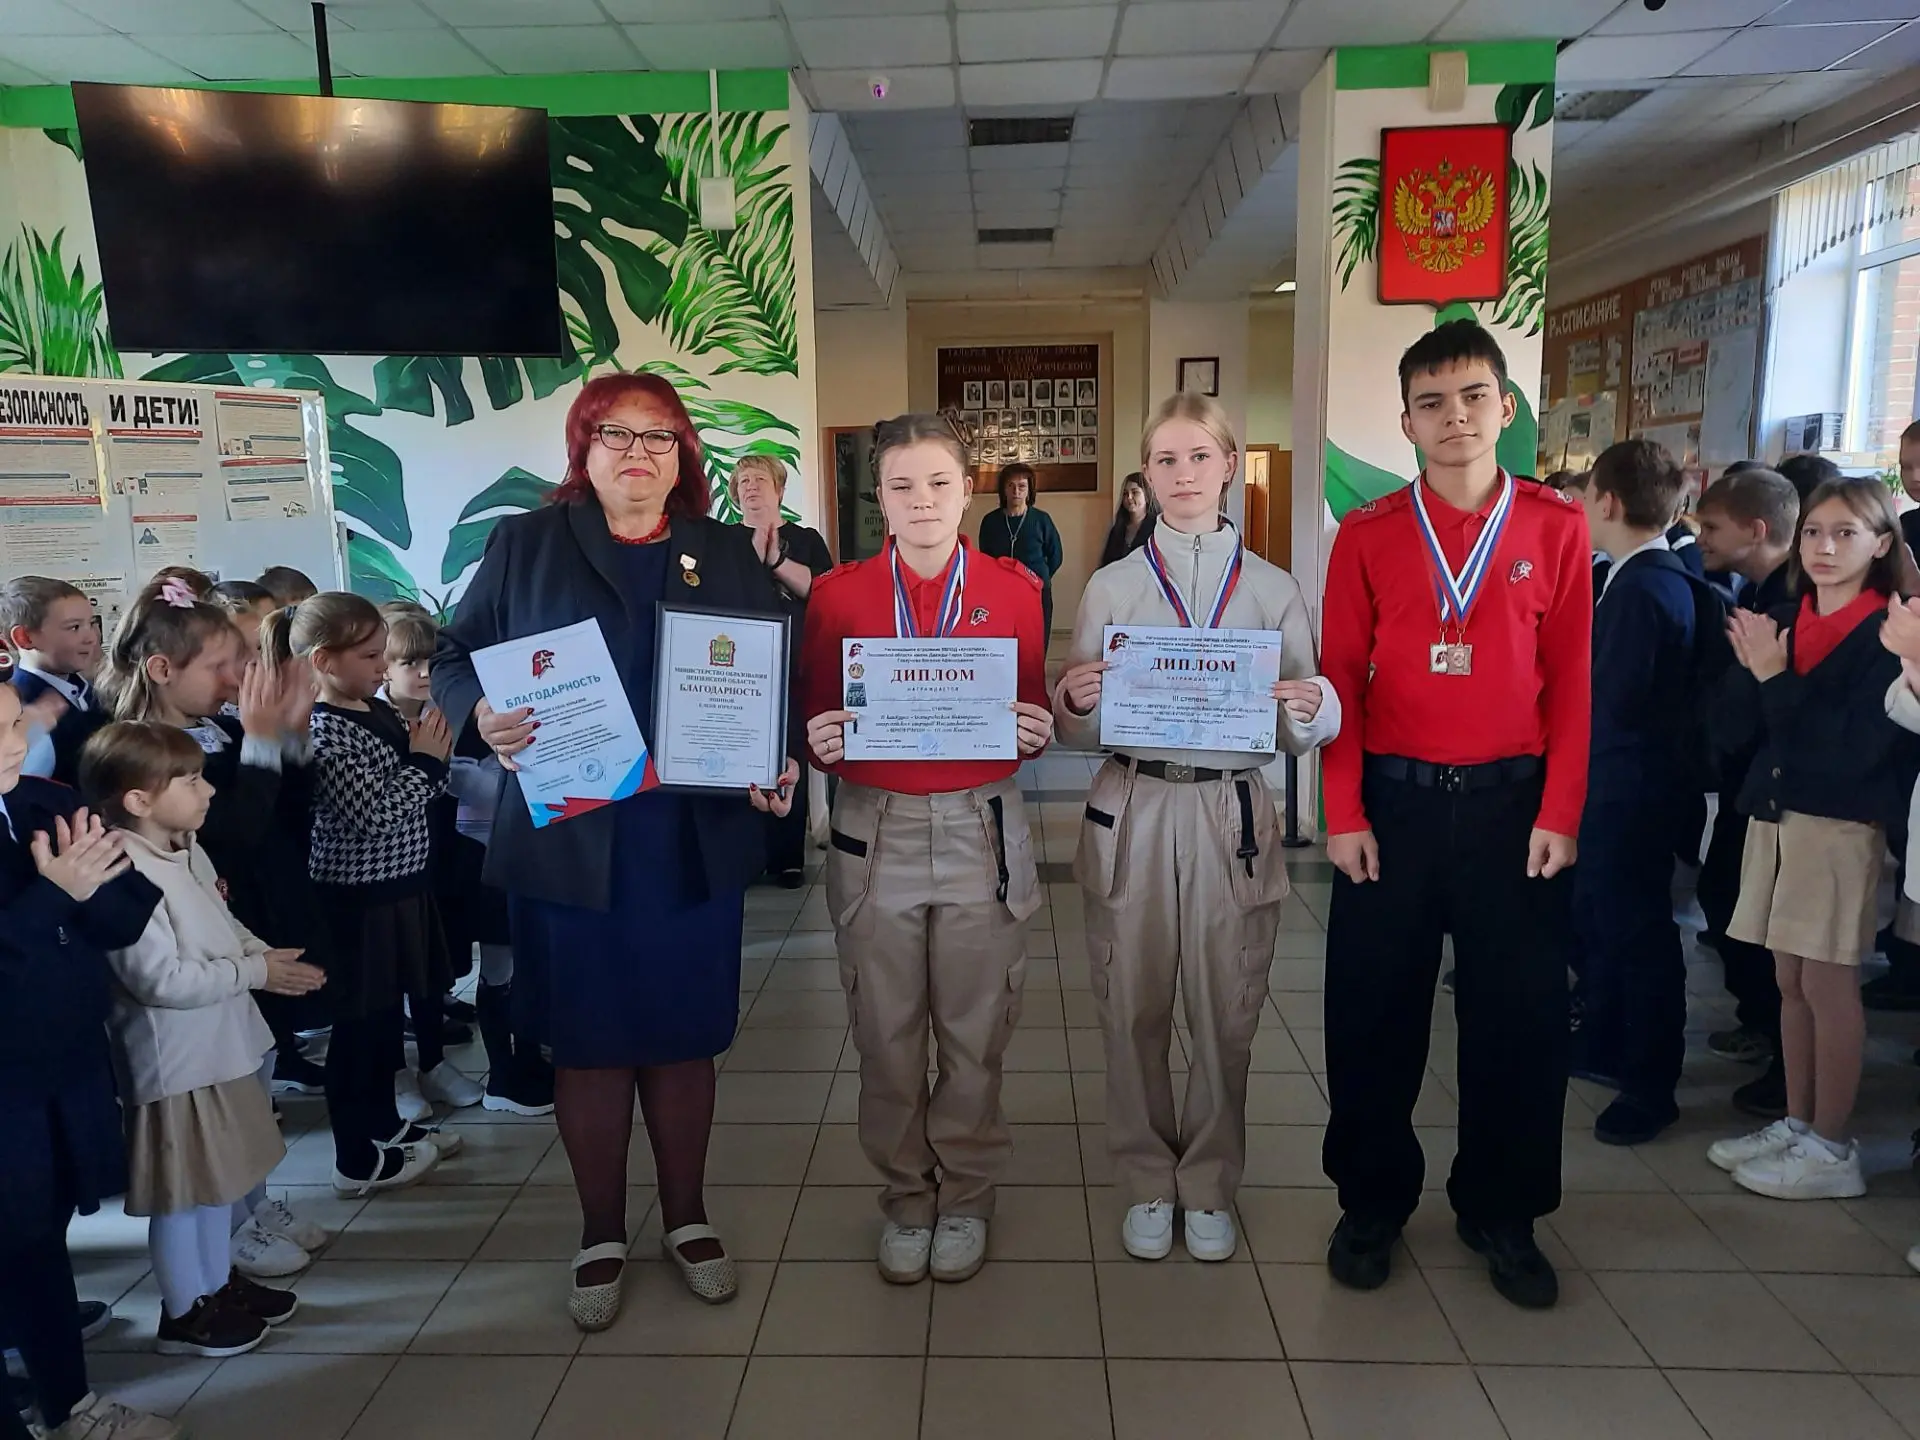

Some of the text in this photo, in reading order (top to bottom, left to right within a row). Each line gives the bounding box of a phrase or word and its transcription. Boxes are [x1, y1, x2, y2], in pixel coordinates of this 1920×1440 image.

[109, 394, 126, 422] И
[133, 395, 199, 428] ДЕТИ!
[1150, 657, 1236, 673] ДИПЛОМ
[890, 669, 975, 684] ДИПЛОМ
[505, 673, 602, 709] БЛАГОДАРНОСТЬ
[679, 683, 762, 697] БЛАГОДАРНОСТЬ
